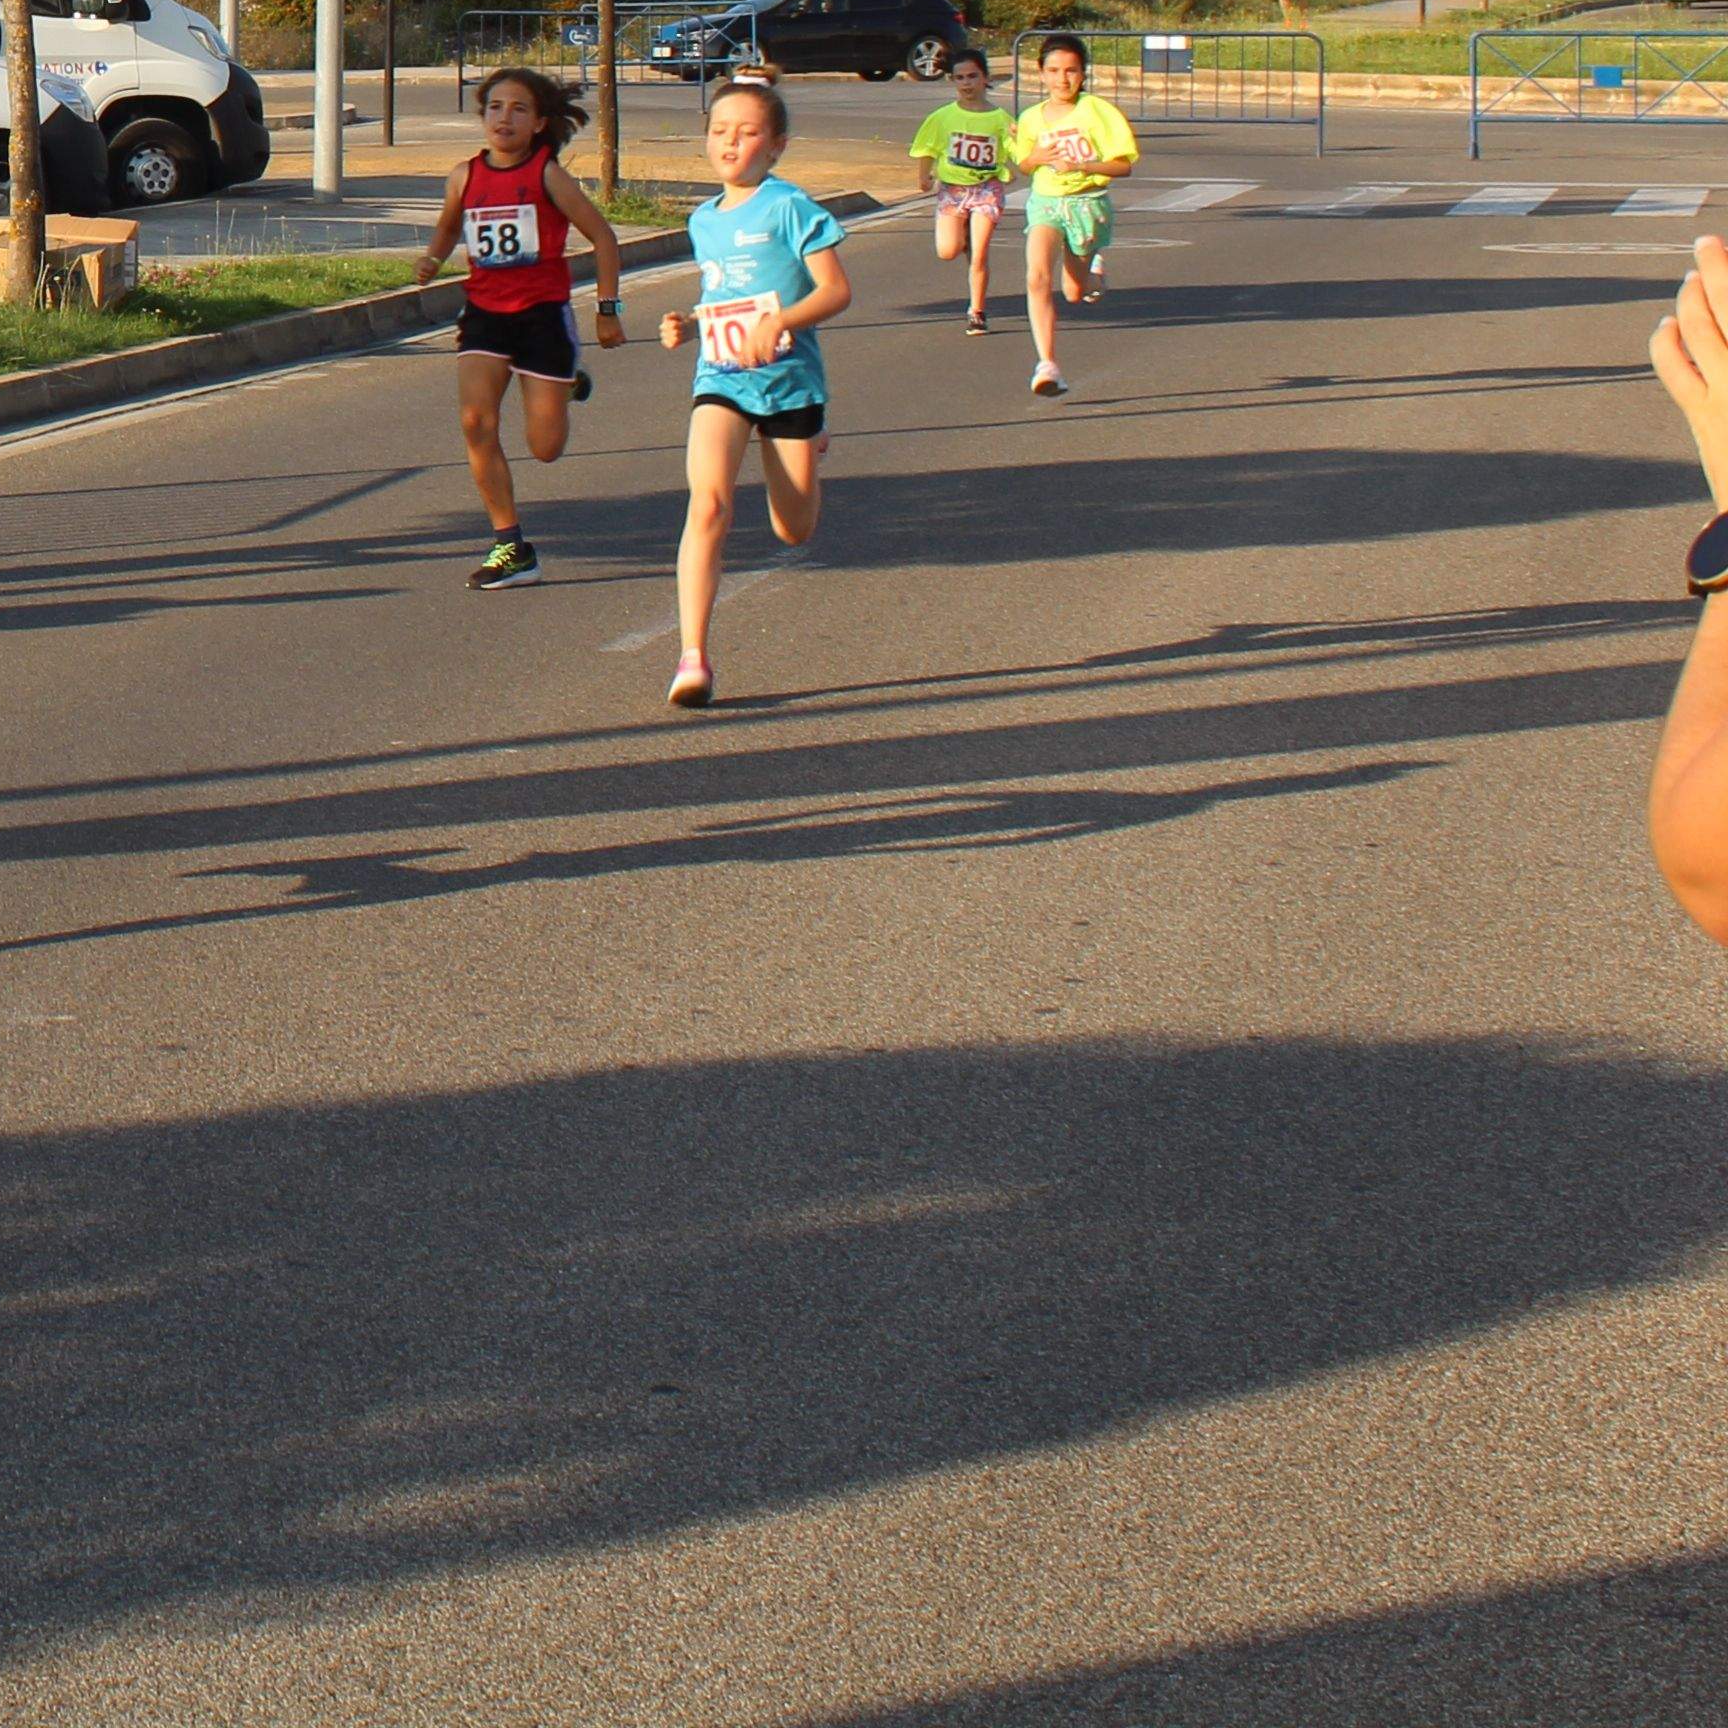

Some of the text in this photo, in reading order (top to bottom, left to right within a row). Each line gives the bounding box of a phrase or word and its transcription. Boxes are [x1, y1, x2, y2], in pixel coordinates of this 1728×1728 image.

[952, 140, 994, 165] 103
[1063, 136, 1092, 161] 00
[477, 223, 520, 257] 58
[706, 320, 748, 363] 10
